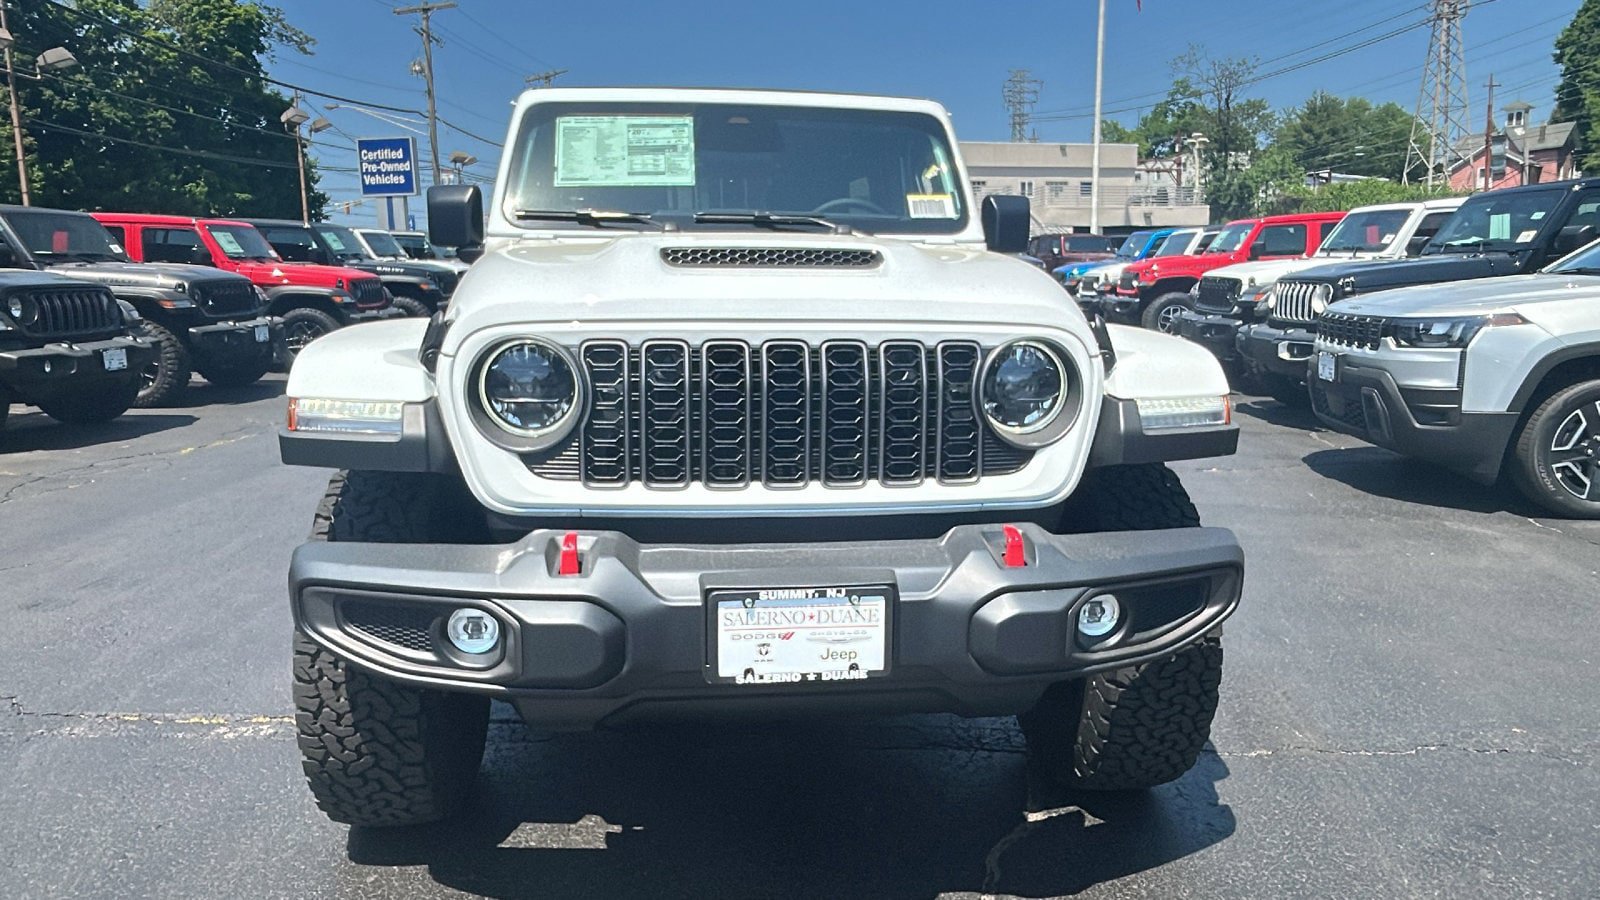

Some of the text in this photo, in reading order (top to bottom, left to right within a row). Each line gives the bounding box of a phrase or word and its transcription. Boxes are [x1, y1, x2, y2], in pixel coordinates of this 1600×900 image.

[361, 148, 403, 160] Certified
[362, 161, 411, 172] Pre-Owned
[363, 174, 405, 185] Vehicles
[826, 588, 846, 598] NJ
[723, 608, 880, 627] SALERNO DUANE
[730, 632, 785, 641] DODGE
[820, 648, 858, 662] Jeep
[735, 670, 868, 685] SALERNO DUANE
